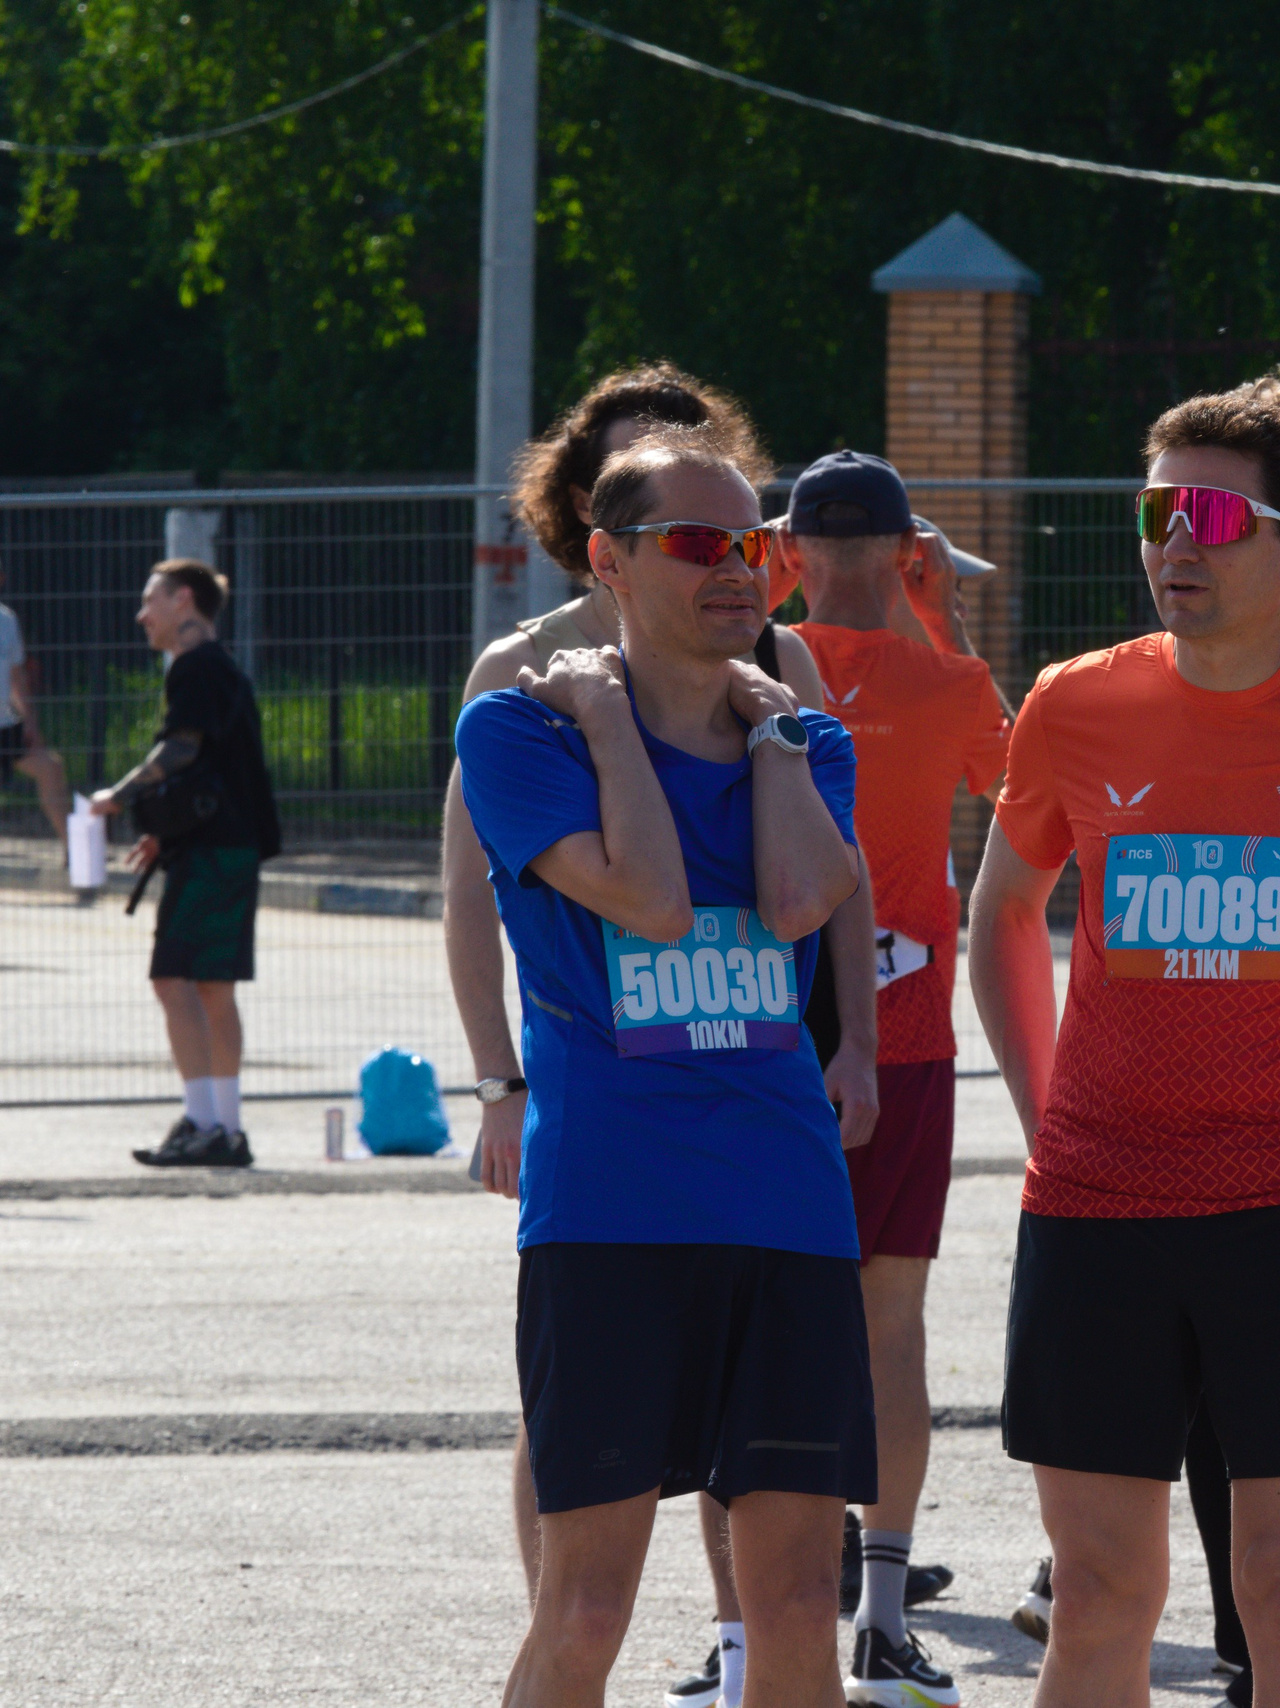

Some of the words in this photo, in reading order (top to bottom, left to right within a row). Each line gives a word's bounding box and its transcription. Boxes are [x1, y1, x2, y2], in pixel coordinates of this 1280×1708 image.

[1128, 849, 1153, 860] ПСБ
[1192, 839, 1224, 870] 10
[618, 947, 789, 1021] 50030
[686, 1019, 748, 1050] 10KM
